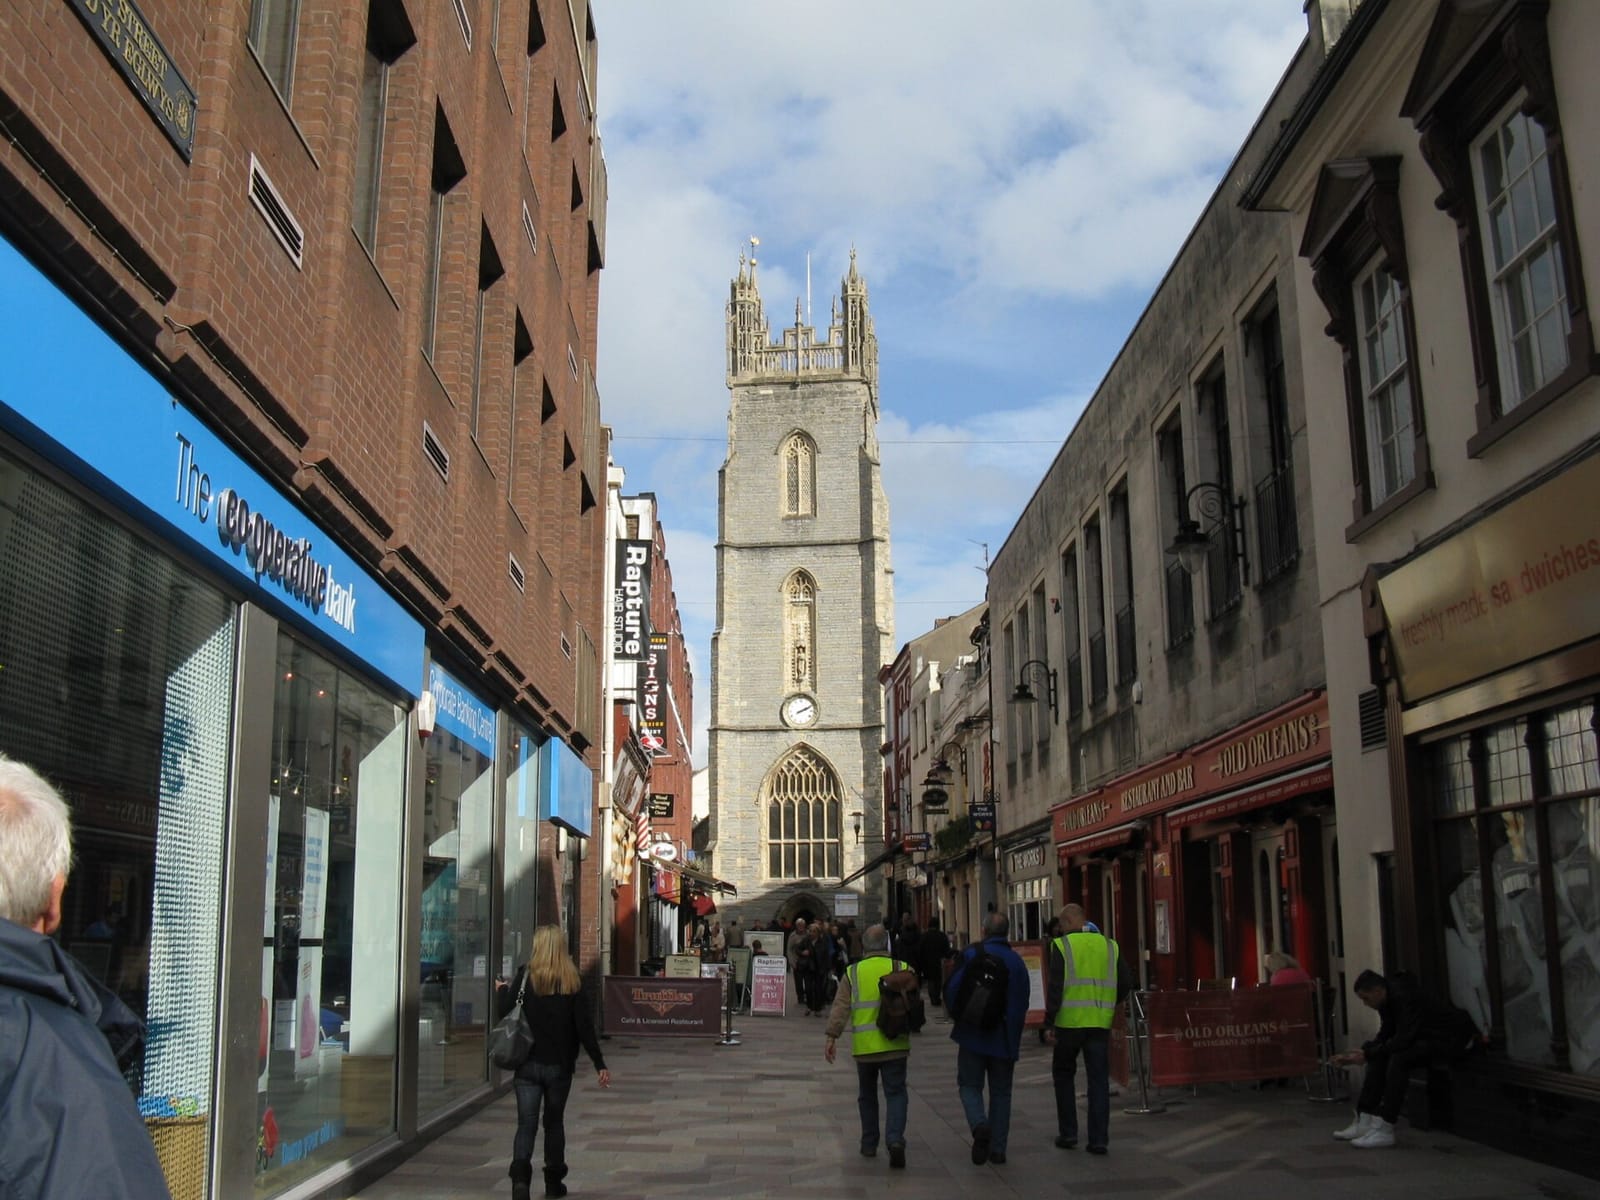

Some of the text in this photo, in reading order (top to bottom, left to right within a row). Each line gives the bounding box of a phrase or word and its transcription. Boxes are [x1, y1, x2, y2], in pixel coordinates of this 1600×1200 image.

[101, 3, 174, 122] YR EGLWYS
[117, 0, 168, 82] STREET
[176, 431, 211, 524] The
[324, 565, 357, 634] bank
[621, 546, 647, 655] Rapture
[614, 616, 624, 654] STUDIO
[457, 691, 477, 739] Banking
[644, 653, 659, 720] SIGNS
[1222, 718, 1310, 777] OLD ORLEANS
[1120, 765, 1194, 813] RESTAURANT AND BAR
[1185, 1021, 1277, 1039] OLD ORLEANS
